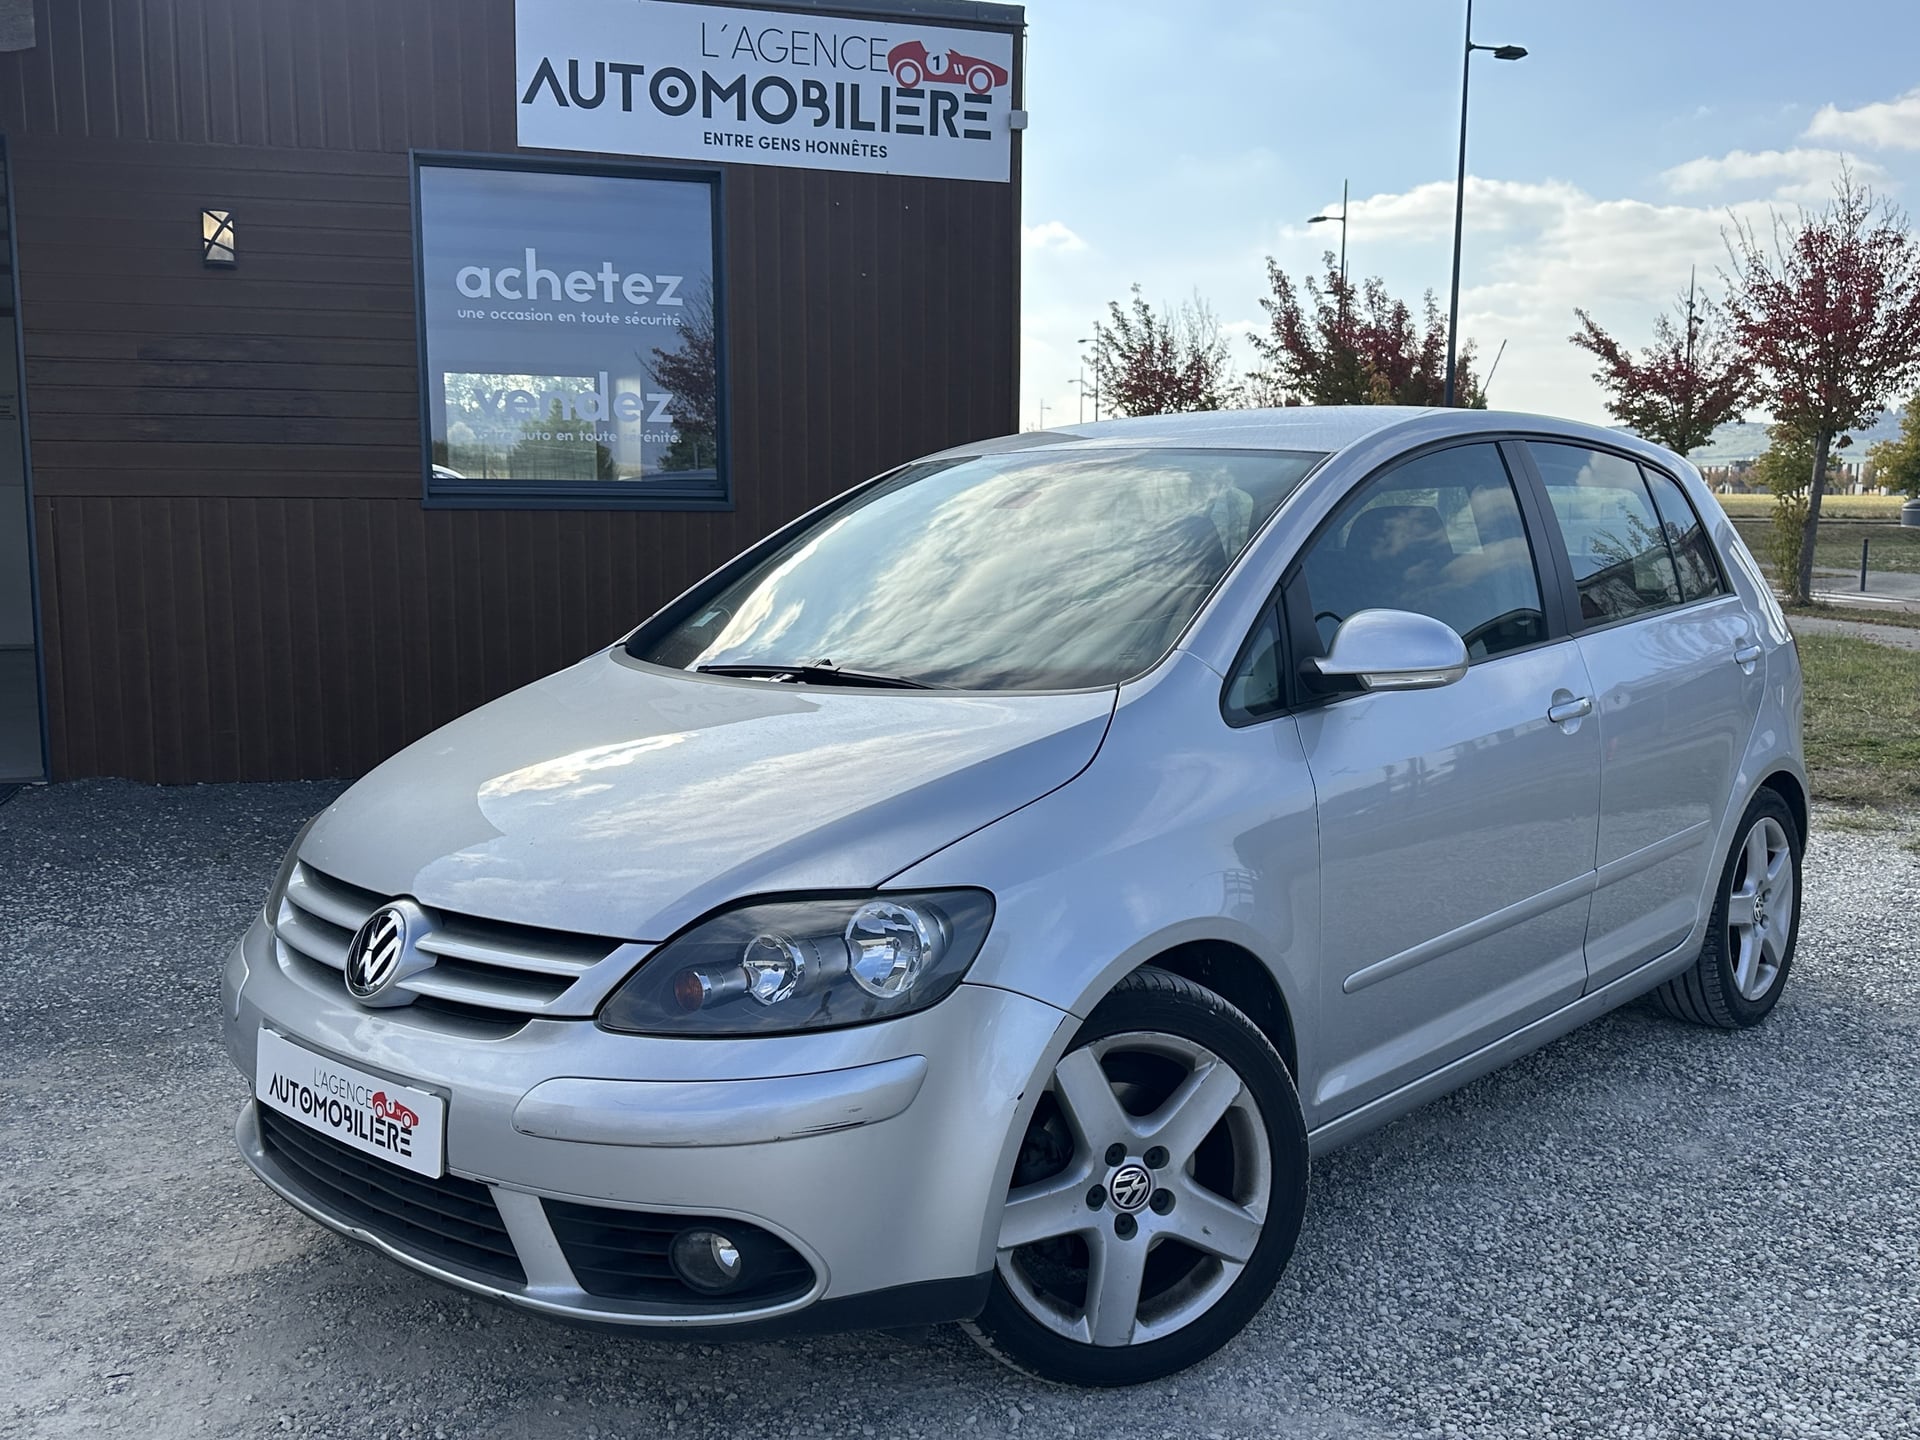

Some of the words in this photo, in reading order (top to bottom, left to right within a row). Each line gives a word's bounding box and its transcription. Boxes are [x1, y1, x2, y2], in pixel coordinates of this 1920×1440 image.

[932, 55, 941, 71] 1
[703, 131, 754, 150] ENTRE
[758, 135, 801, 153] GENS
[805, 138, 888, 159] HONNÊTES
[455, 247, 684, 306] achetez
[457, 308, 486, 320] une
[490, 307, 553, 322] occasion
[558, 312, 576, 323] en
[580, 311, 620, 325] toute
[625, 311, 685, 327] sécurité.
[473, 371, 674, 423] vendez
[556, 431, 574, 442] en
[579, 430, 617, 443] toute
[313, 1067, 373, 1110] L'AGENCE
